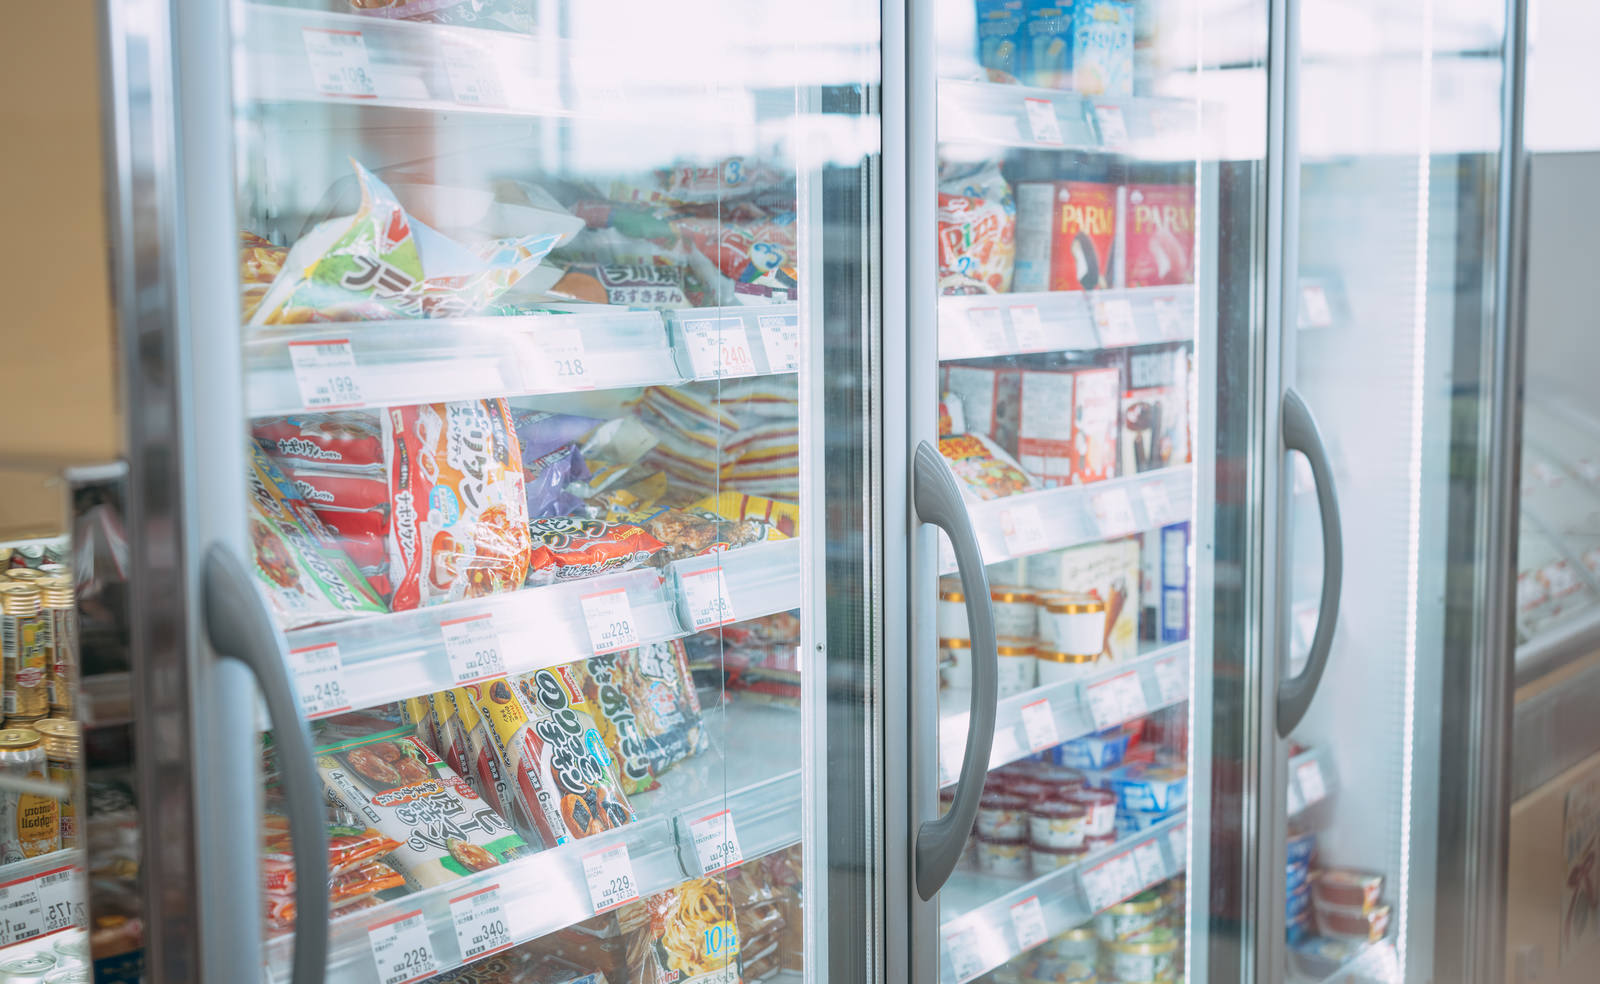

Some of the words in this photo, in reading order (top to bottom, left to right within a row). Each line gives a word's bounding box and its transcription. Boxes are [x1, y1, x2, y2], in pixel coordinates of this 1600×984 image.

[555, 358, 584, 377] 218
[609, 620, 630, 637] 229
[475, 648, 498, 667] 209
[535, 670, 603, 786] のりっこ
[536, 719, 588, 795] チキン
[397, 793, 464, 825] 肉詰め
[610, 875, 630, 893] 229
[482, 919, 504, 940] 340
[404, 946, 427, 968] 229
